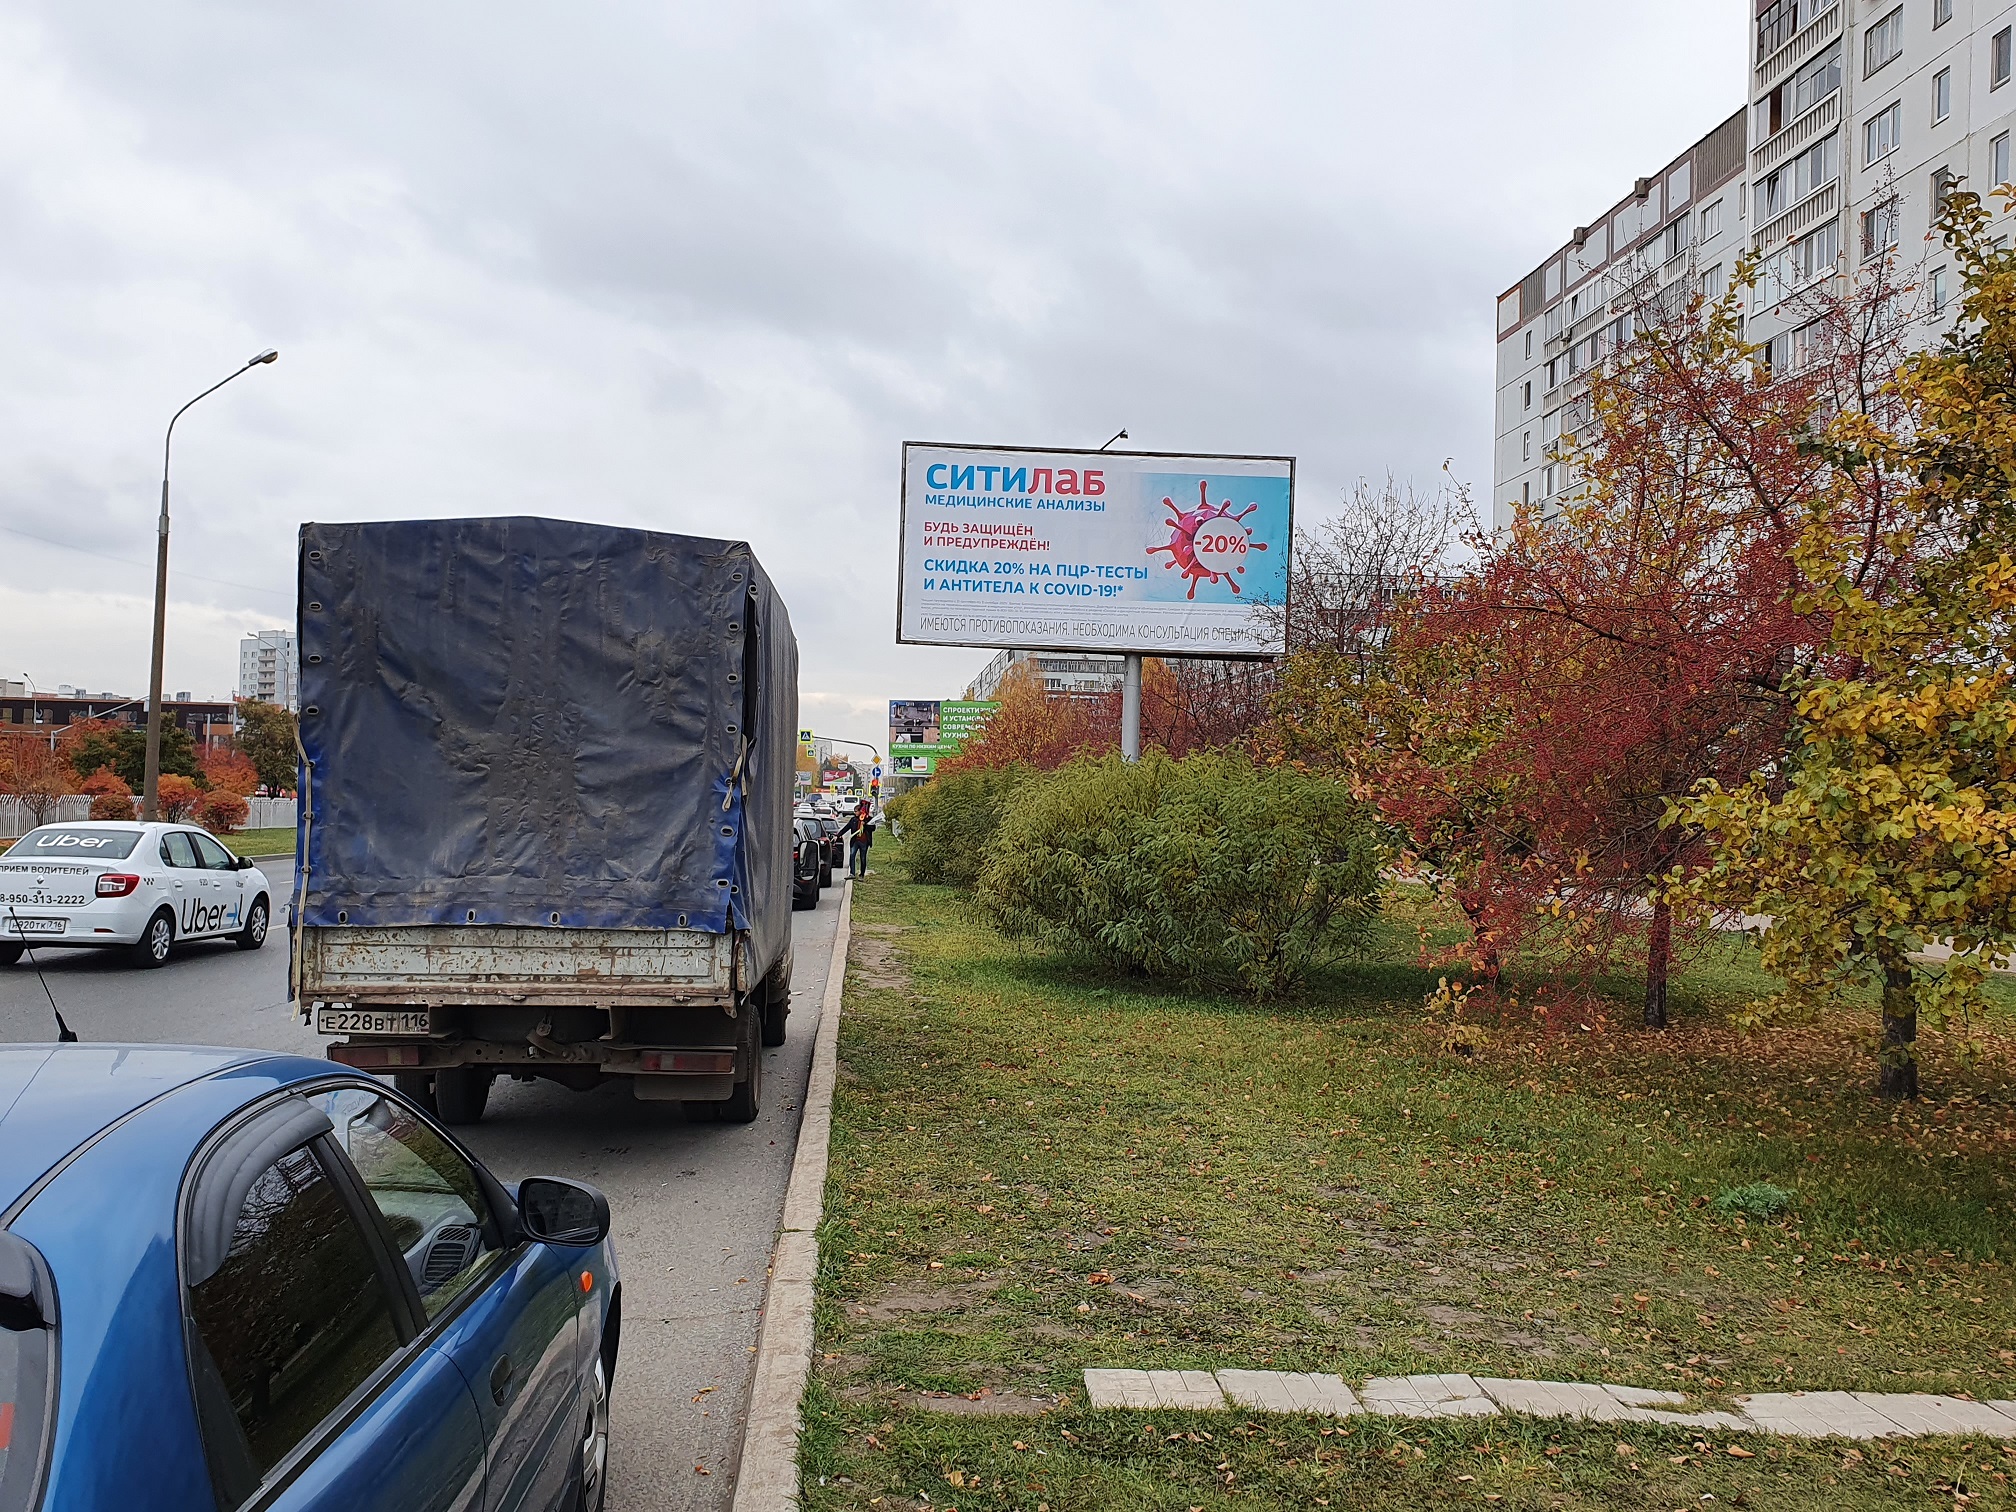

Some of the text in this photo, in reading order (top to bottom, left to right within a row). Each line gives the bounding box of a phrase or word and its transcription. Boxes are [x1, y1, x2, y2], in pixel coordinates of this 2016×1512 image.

[925, 494, 1106, 512] МЕДИЦИНСКИЕ АНАЛИЗЫ
[924, 521, 1033, 536] БУДЬ ЗАЩИЩЁН
[924, 536, 1051, 552] И ПРЕДУПРЕЖДЁН!
[1195, 534, 1247, 554] -20%
[924, 558, 1148, 580] СКИДКА 20% НА ПЦР-ТЕСТЫ
[923, 578, 935, 591] И
[939, 578, 1025, 595] АНТИТЕЛА
[1029, 582, 1040, 595] К
[920, 616, 967, 632] ИМЕЮТСЯ
[968, 618, 1071, 636] ПРОТИВОПОКАЗАНИЯ.
[1072, 622, 1136, 639] НЕОБХОДИМА
[1138, 625, 1209, 642] КОНСУЛЬТАЦИЯ
[36, 834, 114, 849] Uber
[31, 866, 90, 876] ВОДИТЕЛЕЙ
[0, 893, 86, 905] 8-950-313-2222
[181, 897, 227, 934] Uber
